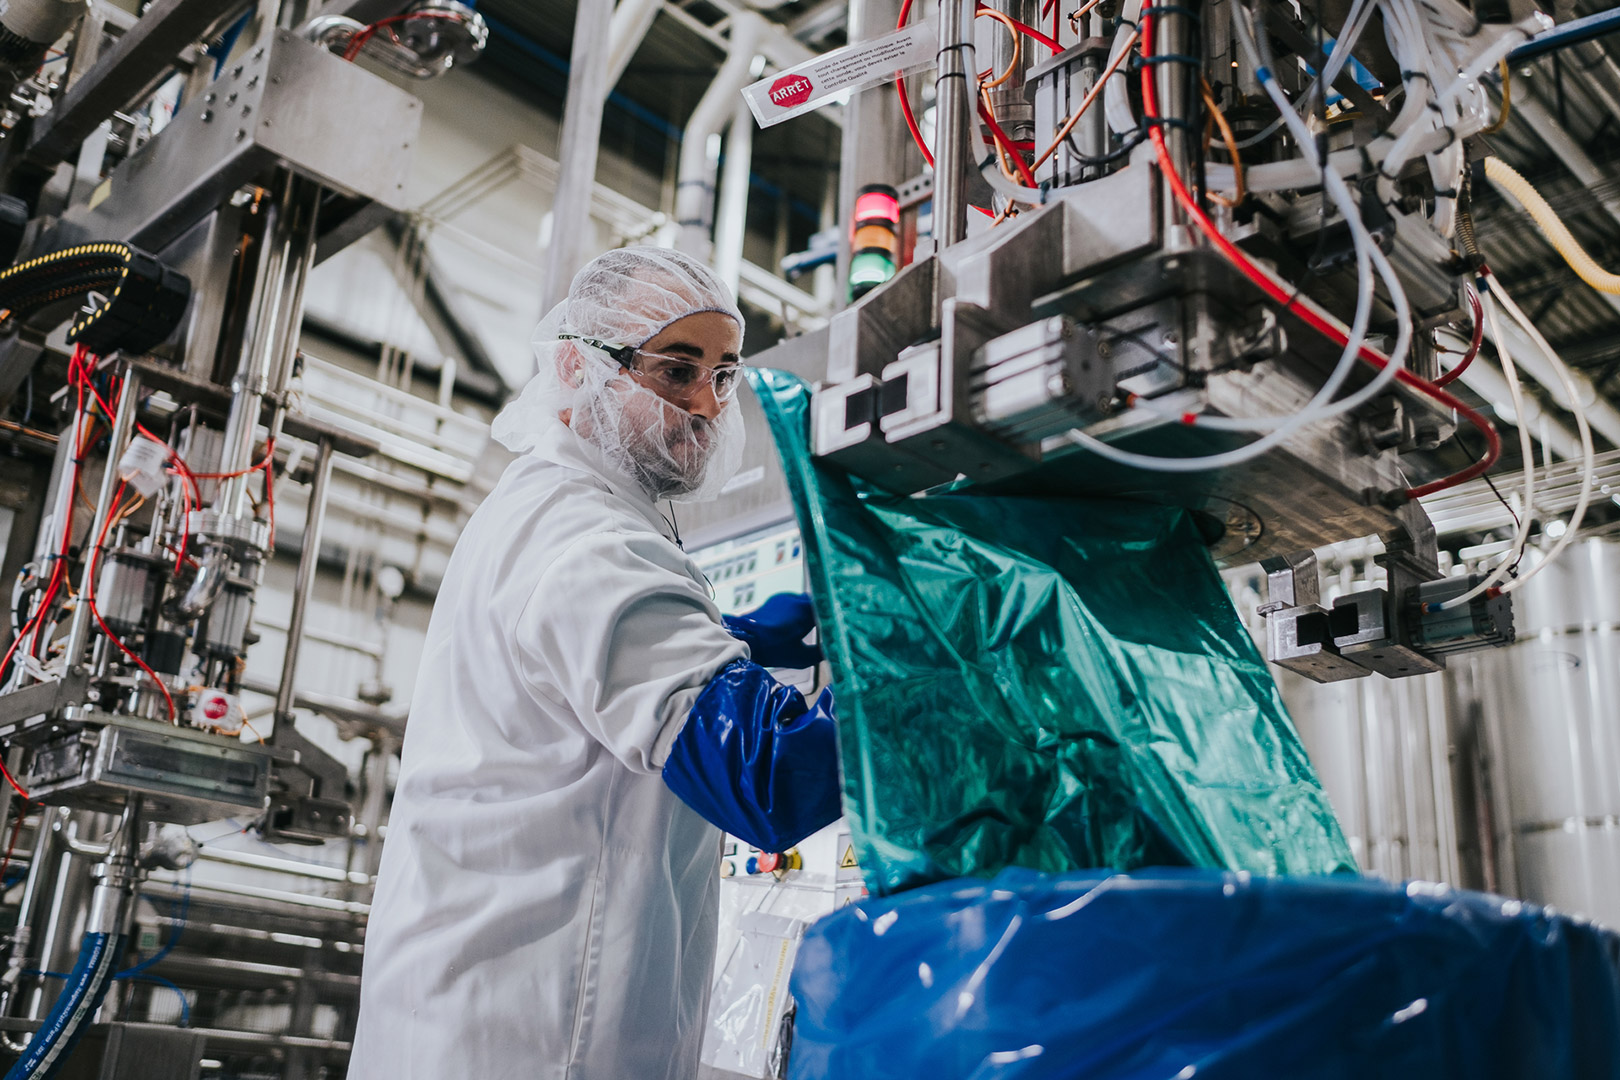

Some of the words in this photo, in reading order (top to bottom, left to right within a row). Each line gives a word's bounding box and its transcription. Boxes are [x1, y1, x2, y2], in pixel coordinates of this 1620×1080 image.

[815, 65, 831, 73] Sonde
[840, 49, 872, 63] température
[896, 36, 911, 44] Avant
[831, 59, 862, 74] changement
[872, 45, 905, 58] modification
[867, 59, 882, 67] devez
[884, 53, 899, 61] aviser
[773, 79, 809, 103] ARRÊT
[824, 78, 847, 90] Contrôle
[848, 71, 867, 82] Qualité
